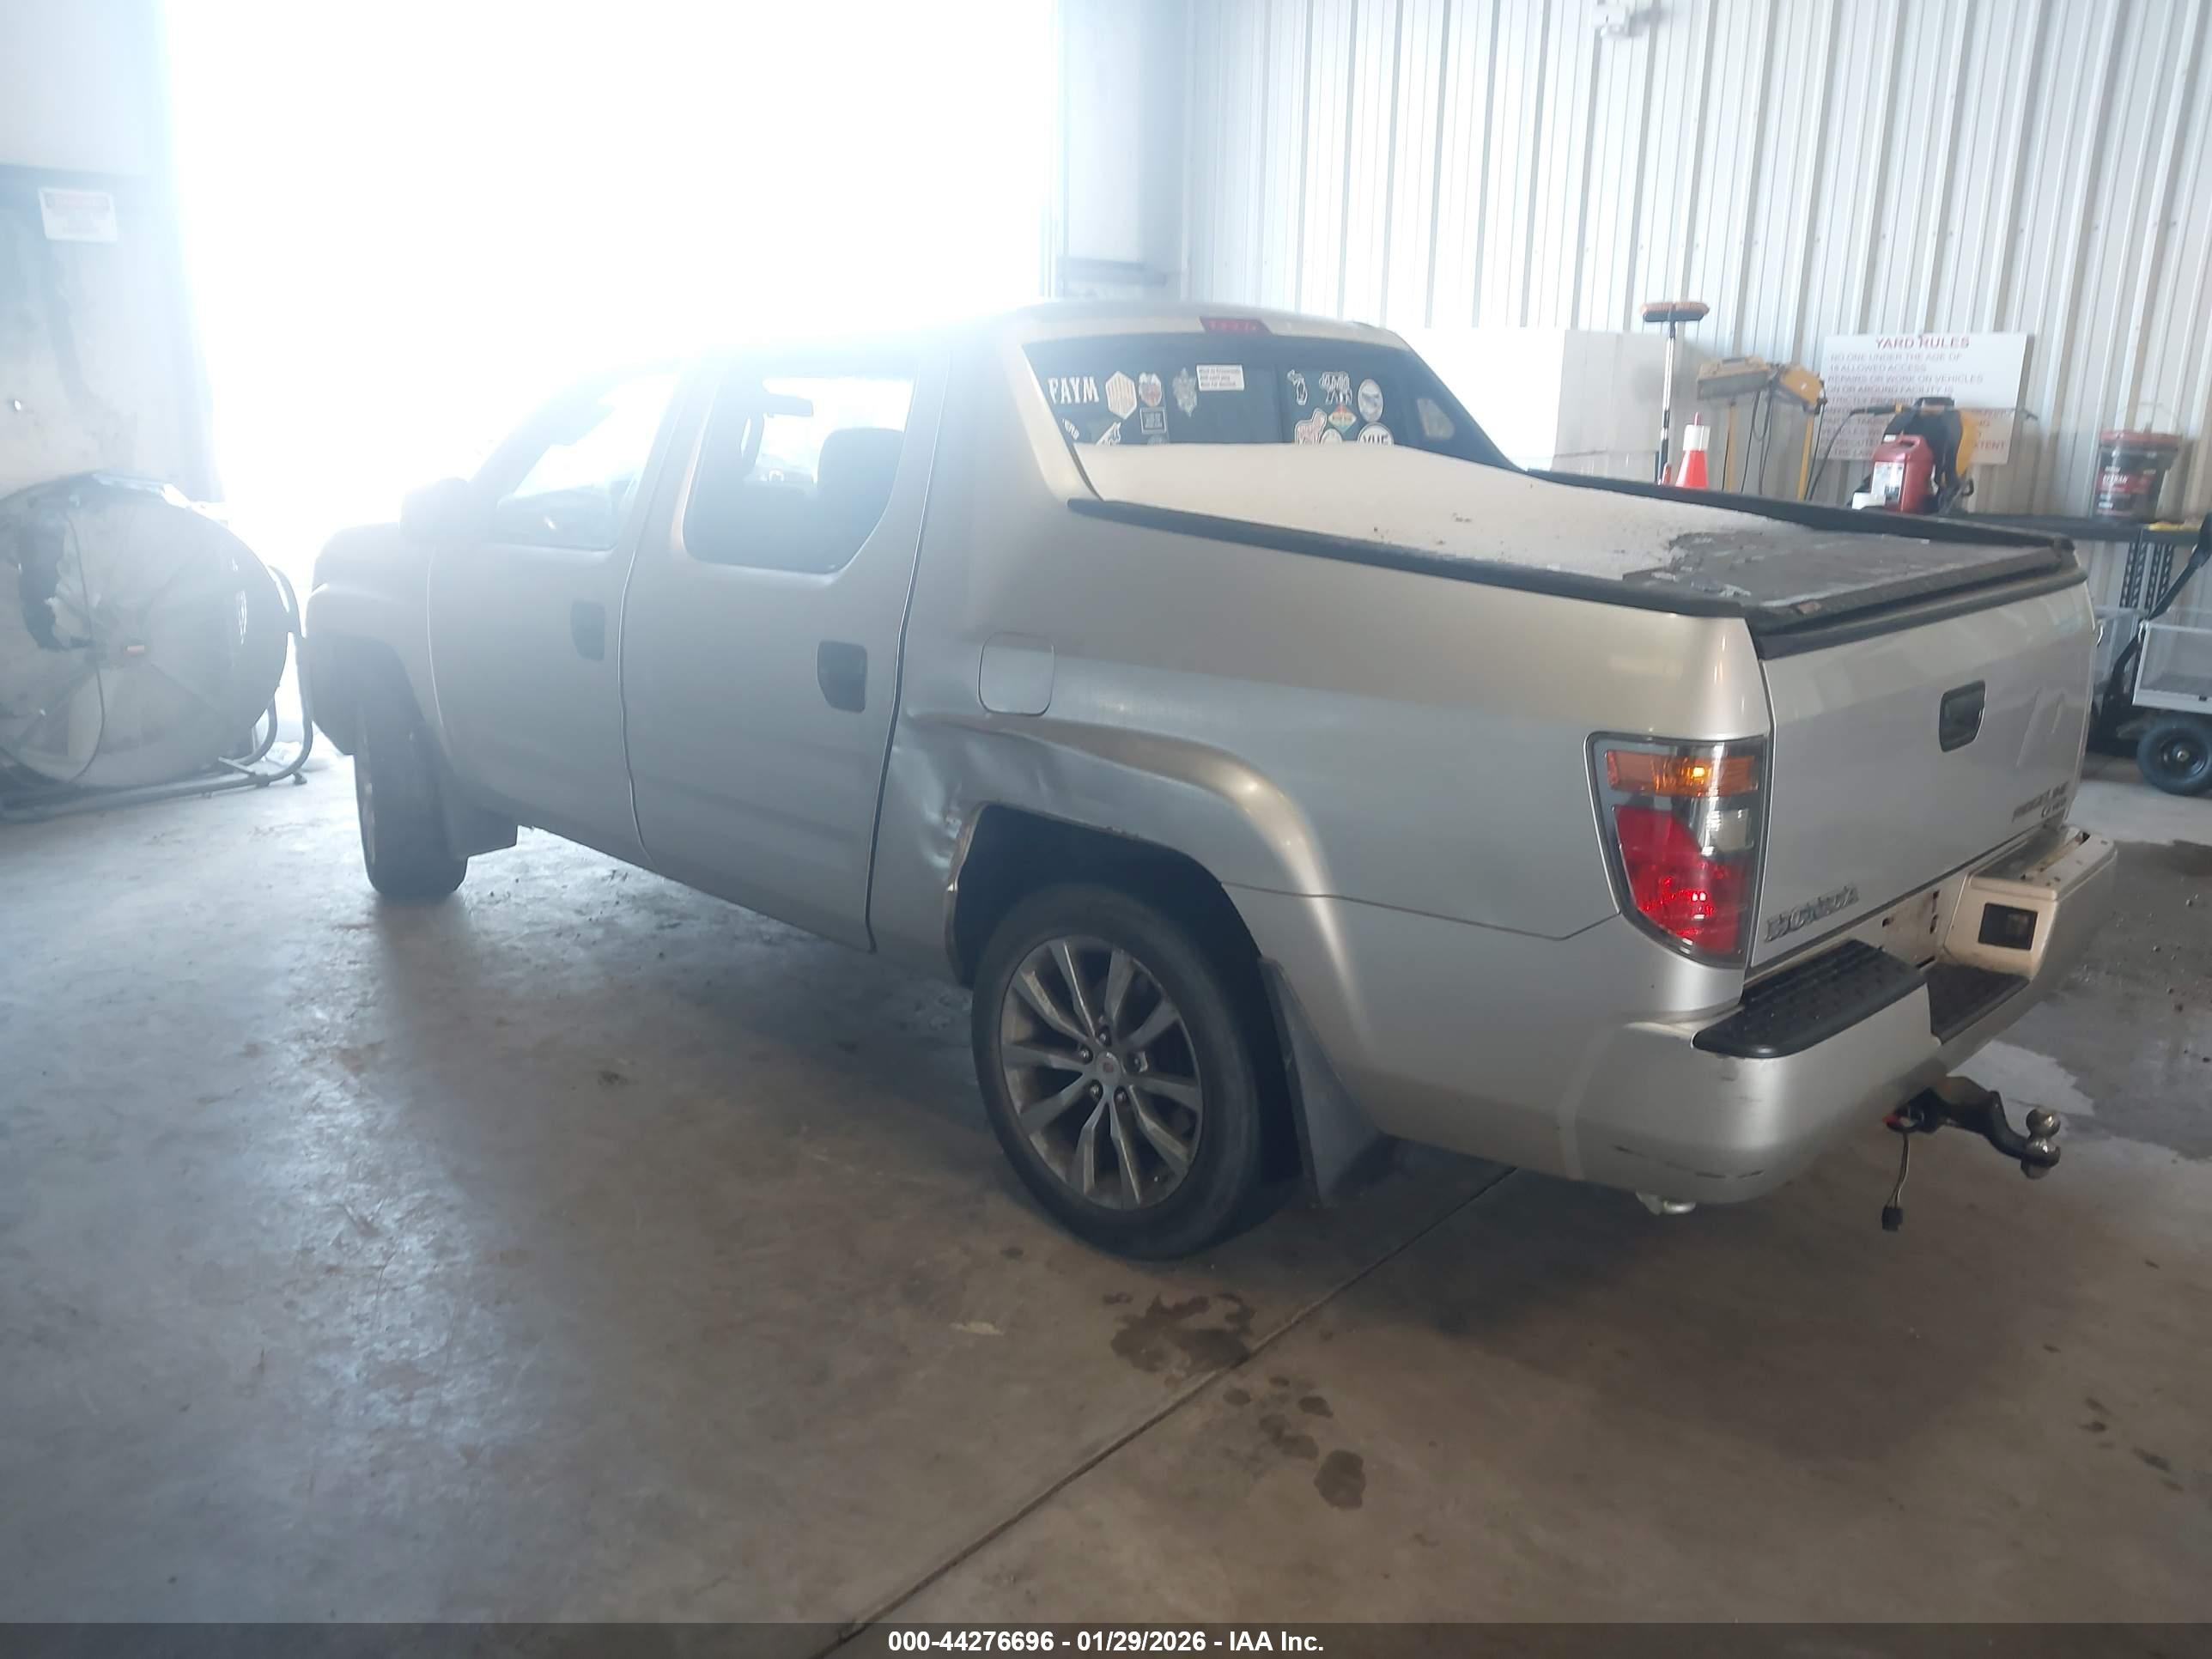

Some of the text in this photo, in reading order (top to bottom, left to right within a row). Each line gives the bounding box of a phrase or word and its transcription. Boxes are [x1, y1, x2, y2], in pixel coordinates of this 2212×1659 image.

[1875, 336, 1971, 349] YARD RULES
[1936, 373, 1984, 384] VEHICLES
